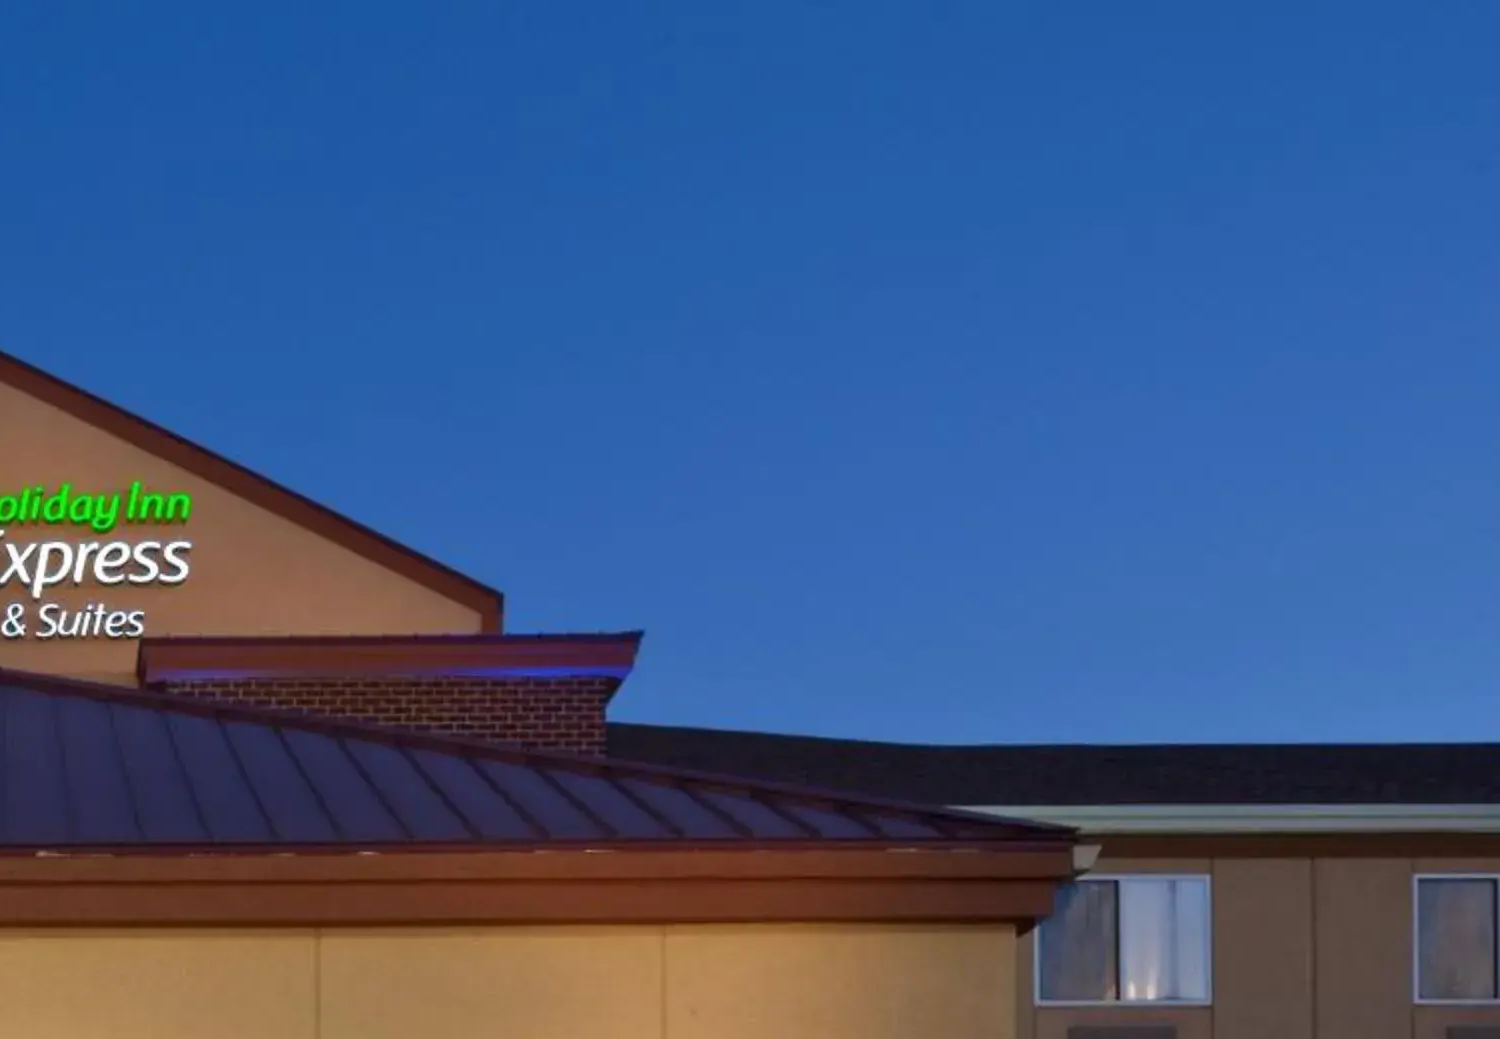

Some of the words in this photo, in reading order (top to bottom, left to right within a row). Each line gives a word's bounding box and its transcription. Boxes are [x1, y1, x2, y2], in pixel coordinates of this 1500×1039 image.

[126, 481, 191, 521] Inn
[1, 603, 26, 637] &
[35, 603, 145, 638] Suites
